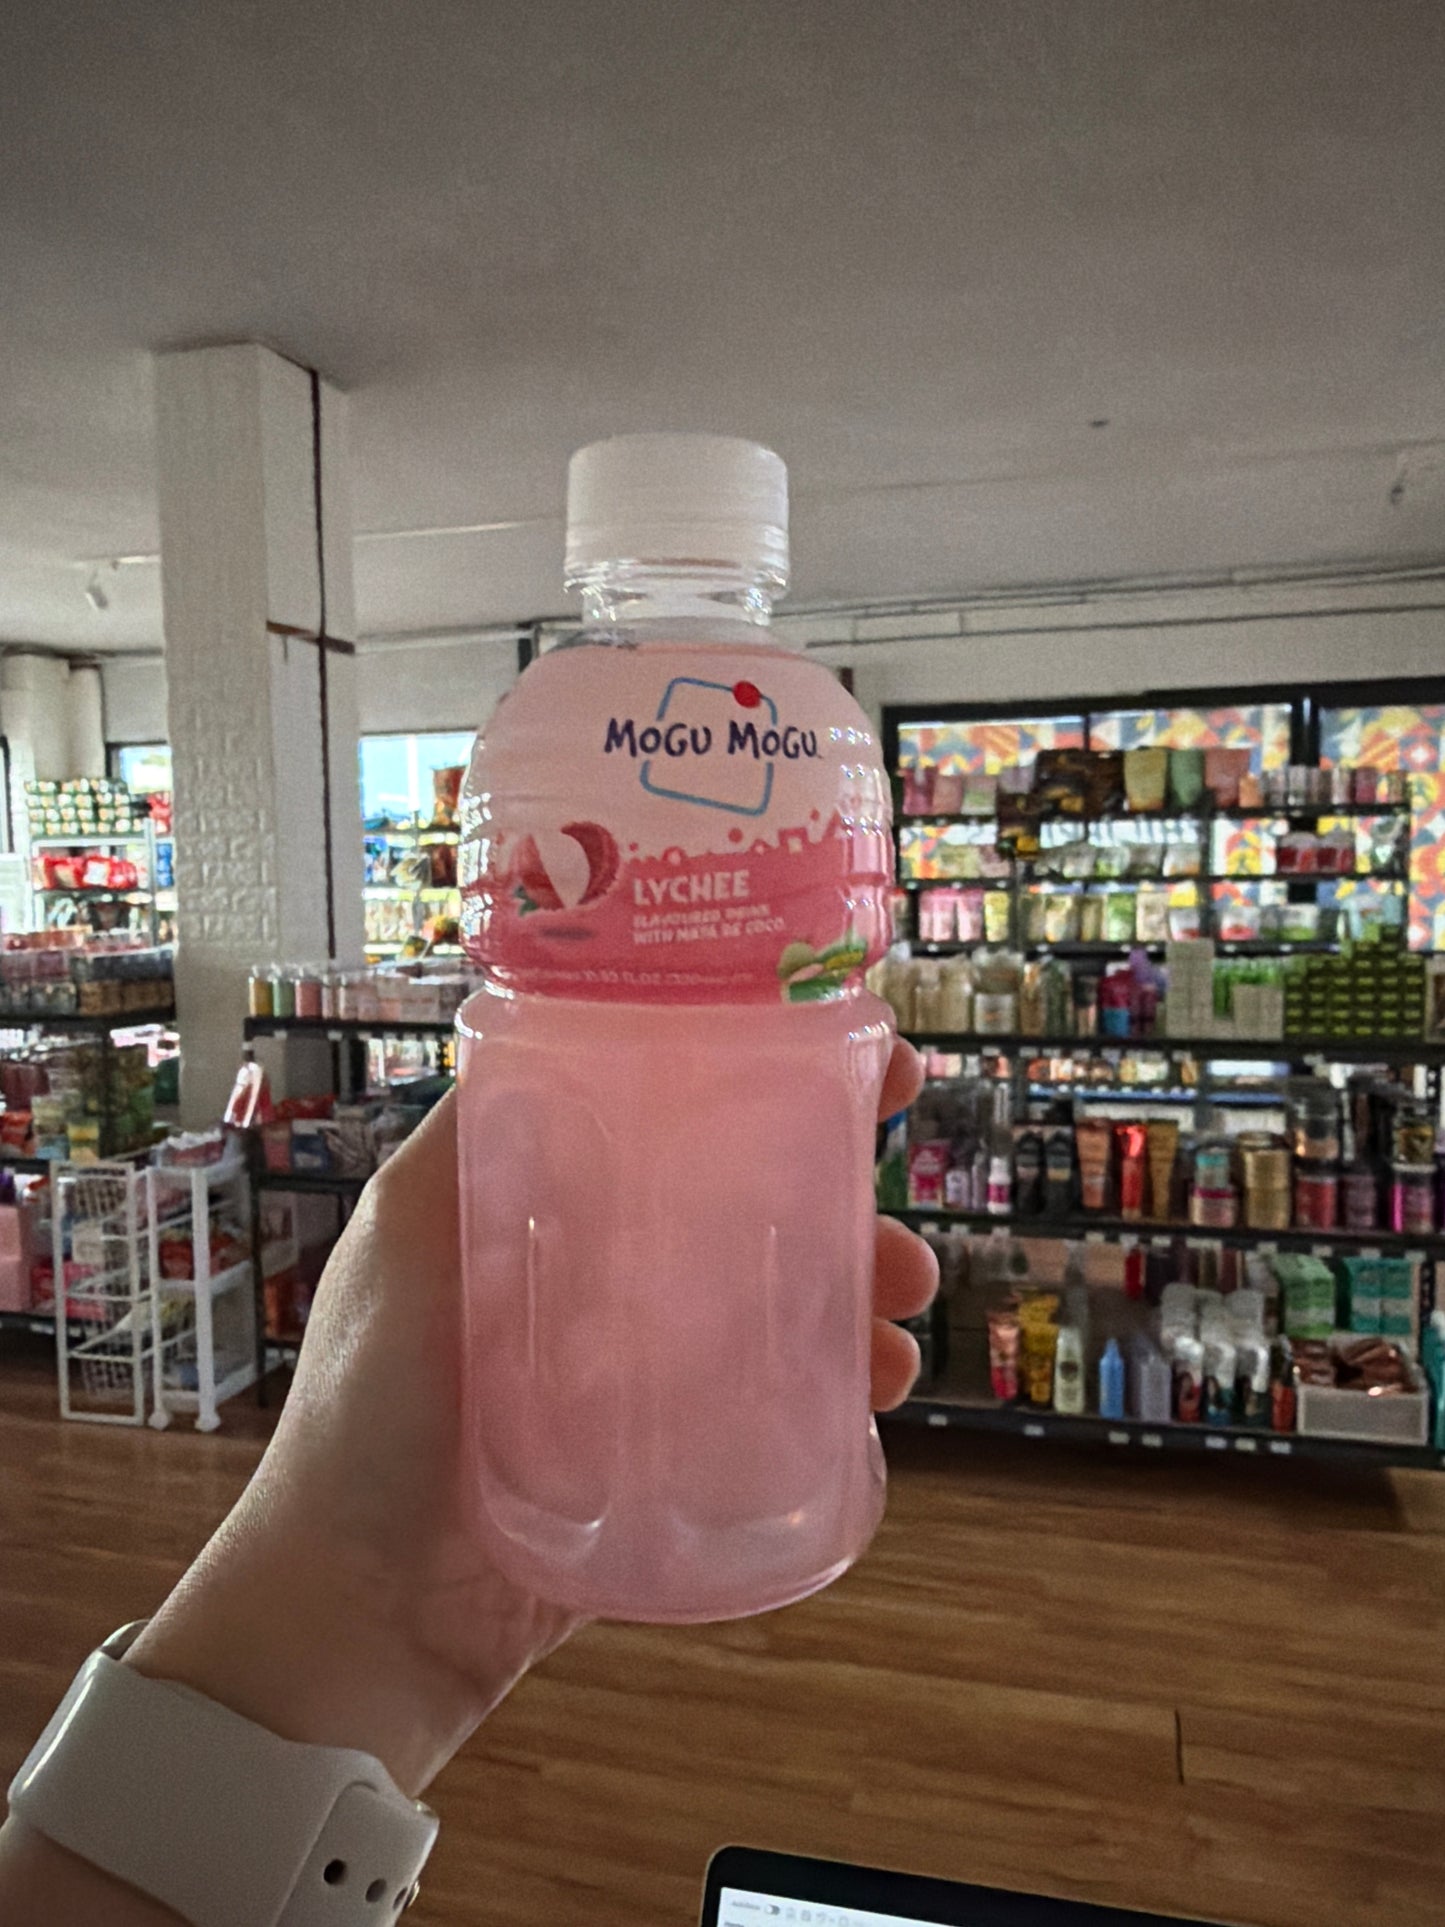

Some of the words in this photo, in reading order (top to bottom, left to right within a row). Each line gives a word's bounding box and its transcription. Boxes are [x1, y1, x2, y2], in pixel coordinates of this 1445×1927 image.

[604, 717, 713, 758] MOGU
[728, 719, 819, 760] MOGU
[632, 868, 750, 907] LYCHEE
[632, 928, 674, 945] WITH
